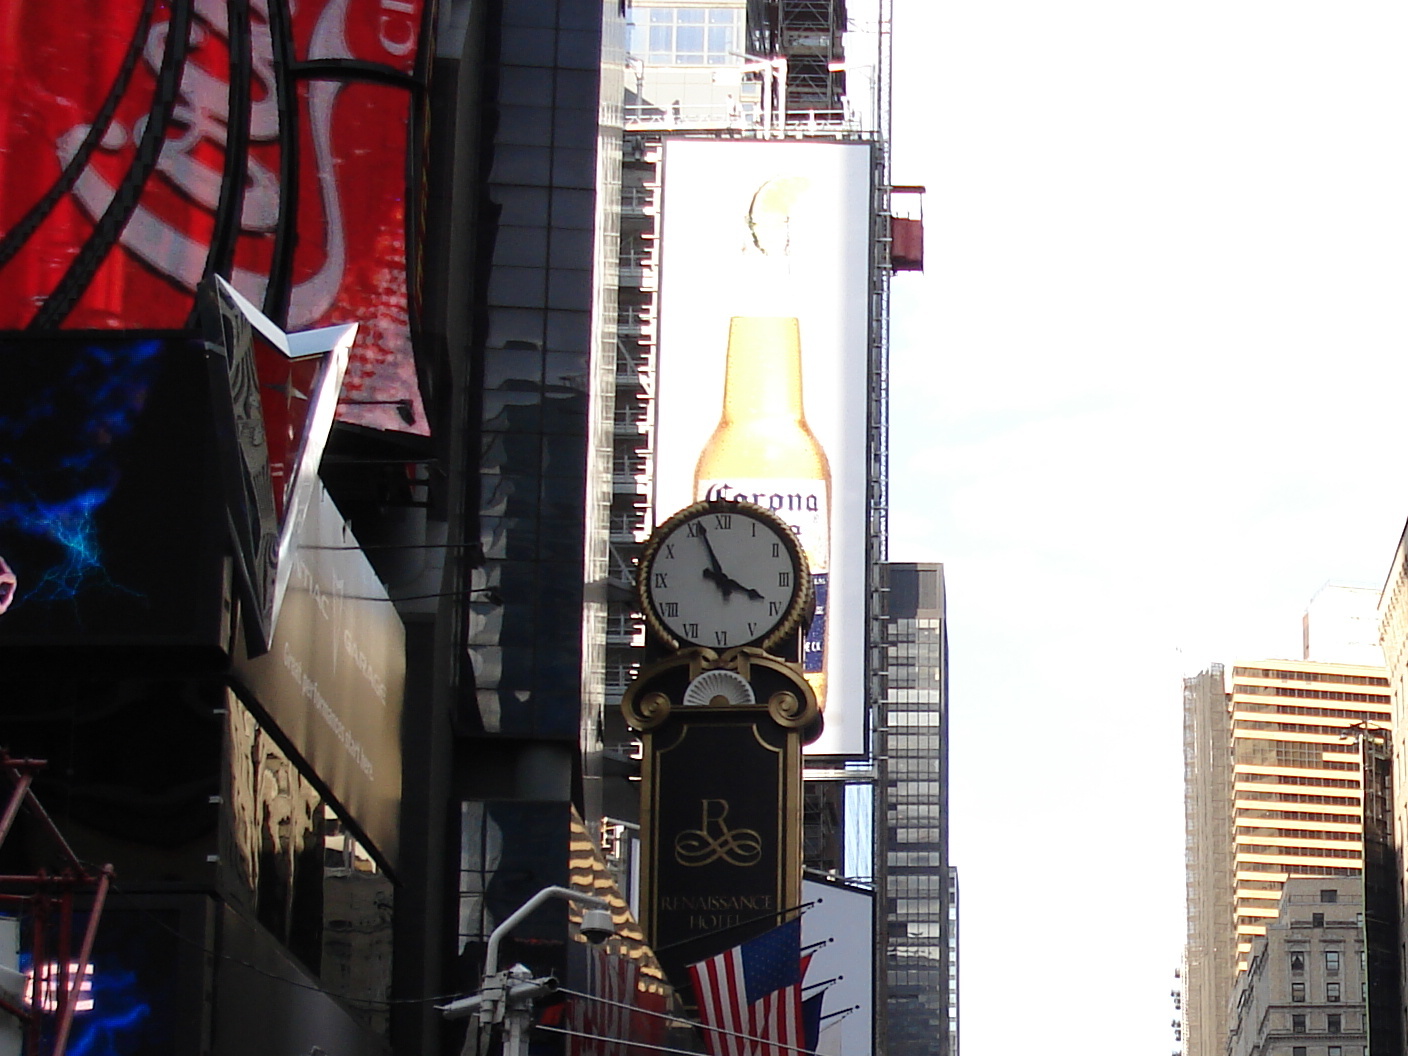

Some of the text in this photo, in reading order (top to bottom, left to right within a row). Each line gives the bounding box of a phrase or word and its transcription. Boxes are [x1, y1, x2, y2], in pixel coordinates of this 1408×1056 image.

[715, 516, 732, 530] XII
[665, 543, 675, 559] X
[772, 543, 780, 558] II
[655, 573, 668, 588] IX
[778, 573, 790, 587] III
[659, 603, 679, 617] VIII
[768, 602, 782, 617] IV
[682, 623, 699, 638] VII
[747, 623, 757, 638] V
[715, 631, 728, 646] VI
[661, 895, 772, 910] RENAISSANCE
